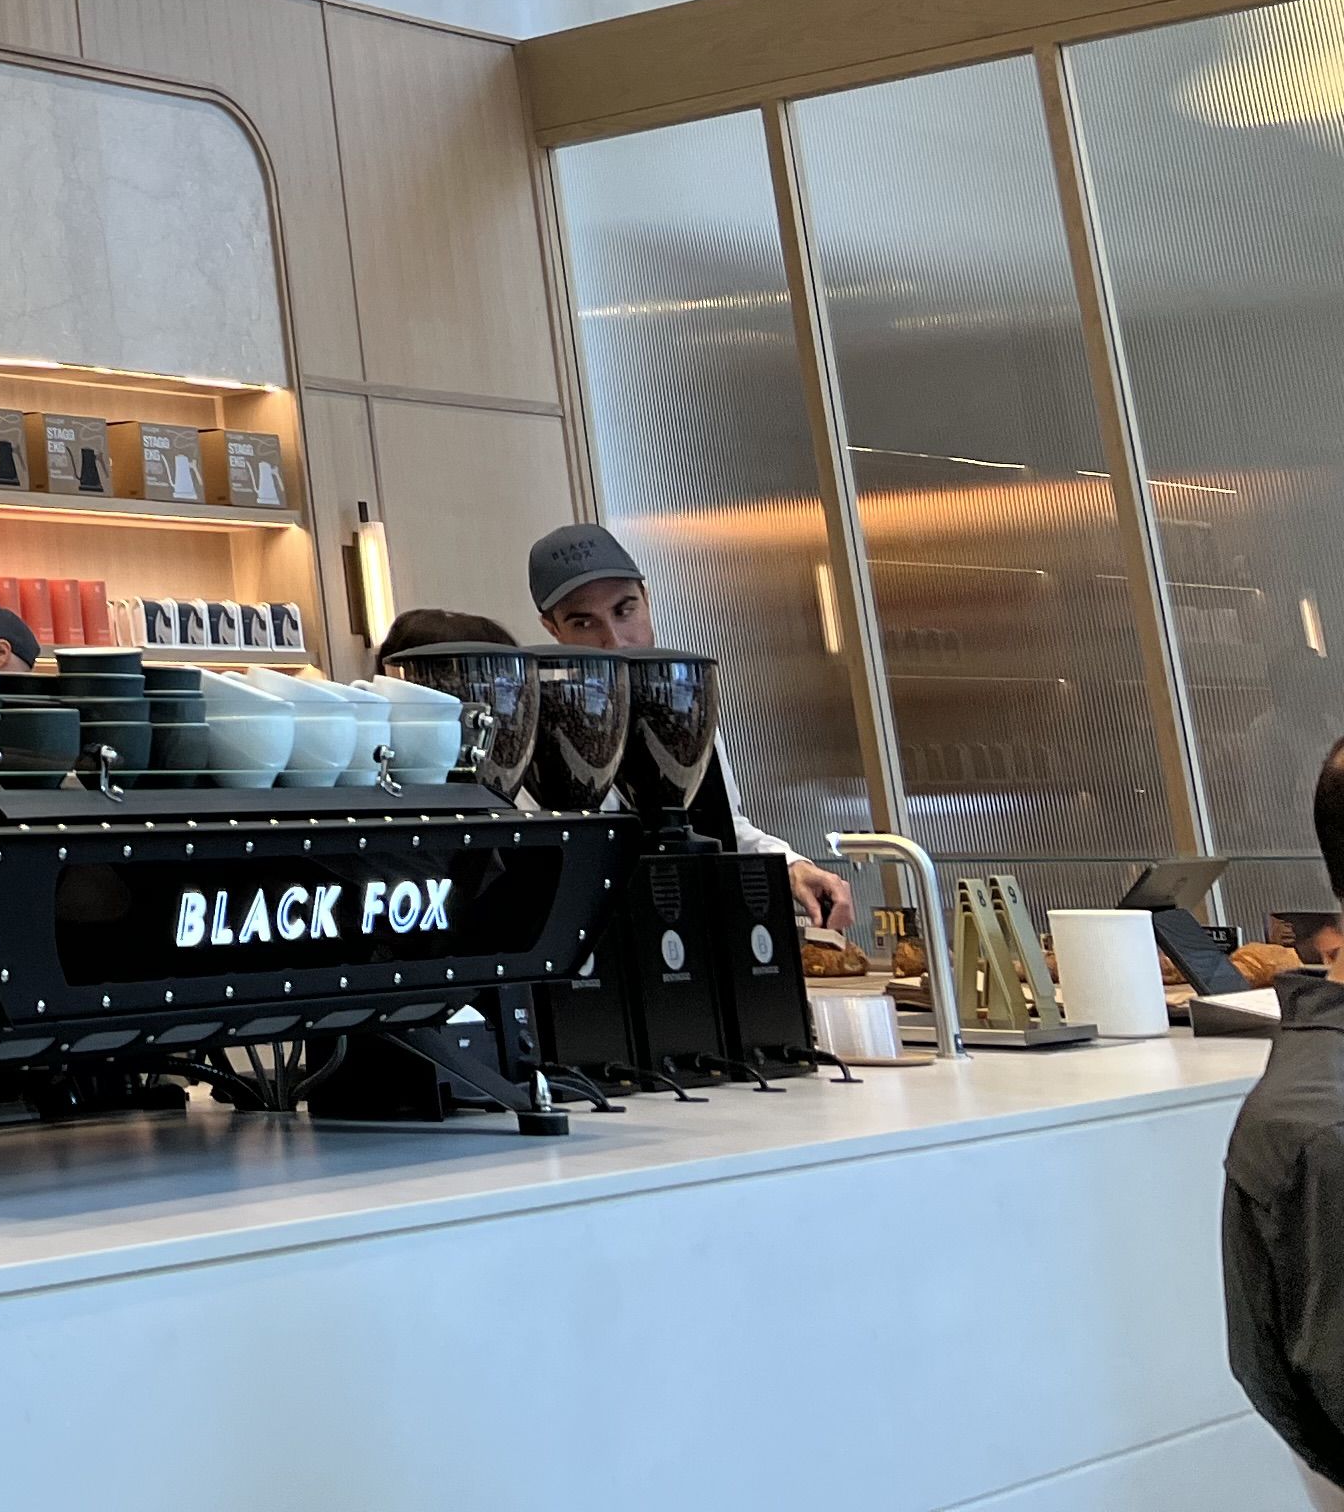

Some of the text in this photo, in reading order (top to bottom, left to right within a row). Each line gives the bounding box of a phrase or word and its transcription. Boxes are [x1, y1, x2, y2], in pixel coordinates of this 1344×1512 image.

[551, 539, 596, 561] BLACK
[563, 549, 593, 565] FOX
[977, 889, 987, 907] 8
[1007, 885, 1018, 904] 9
[175, 878, 453, 948] BLACK FOX
